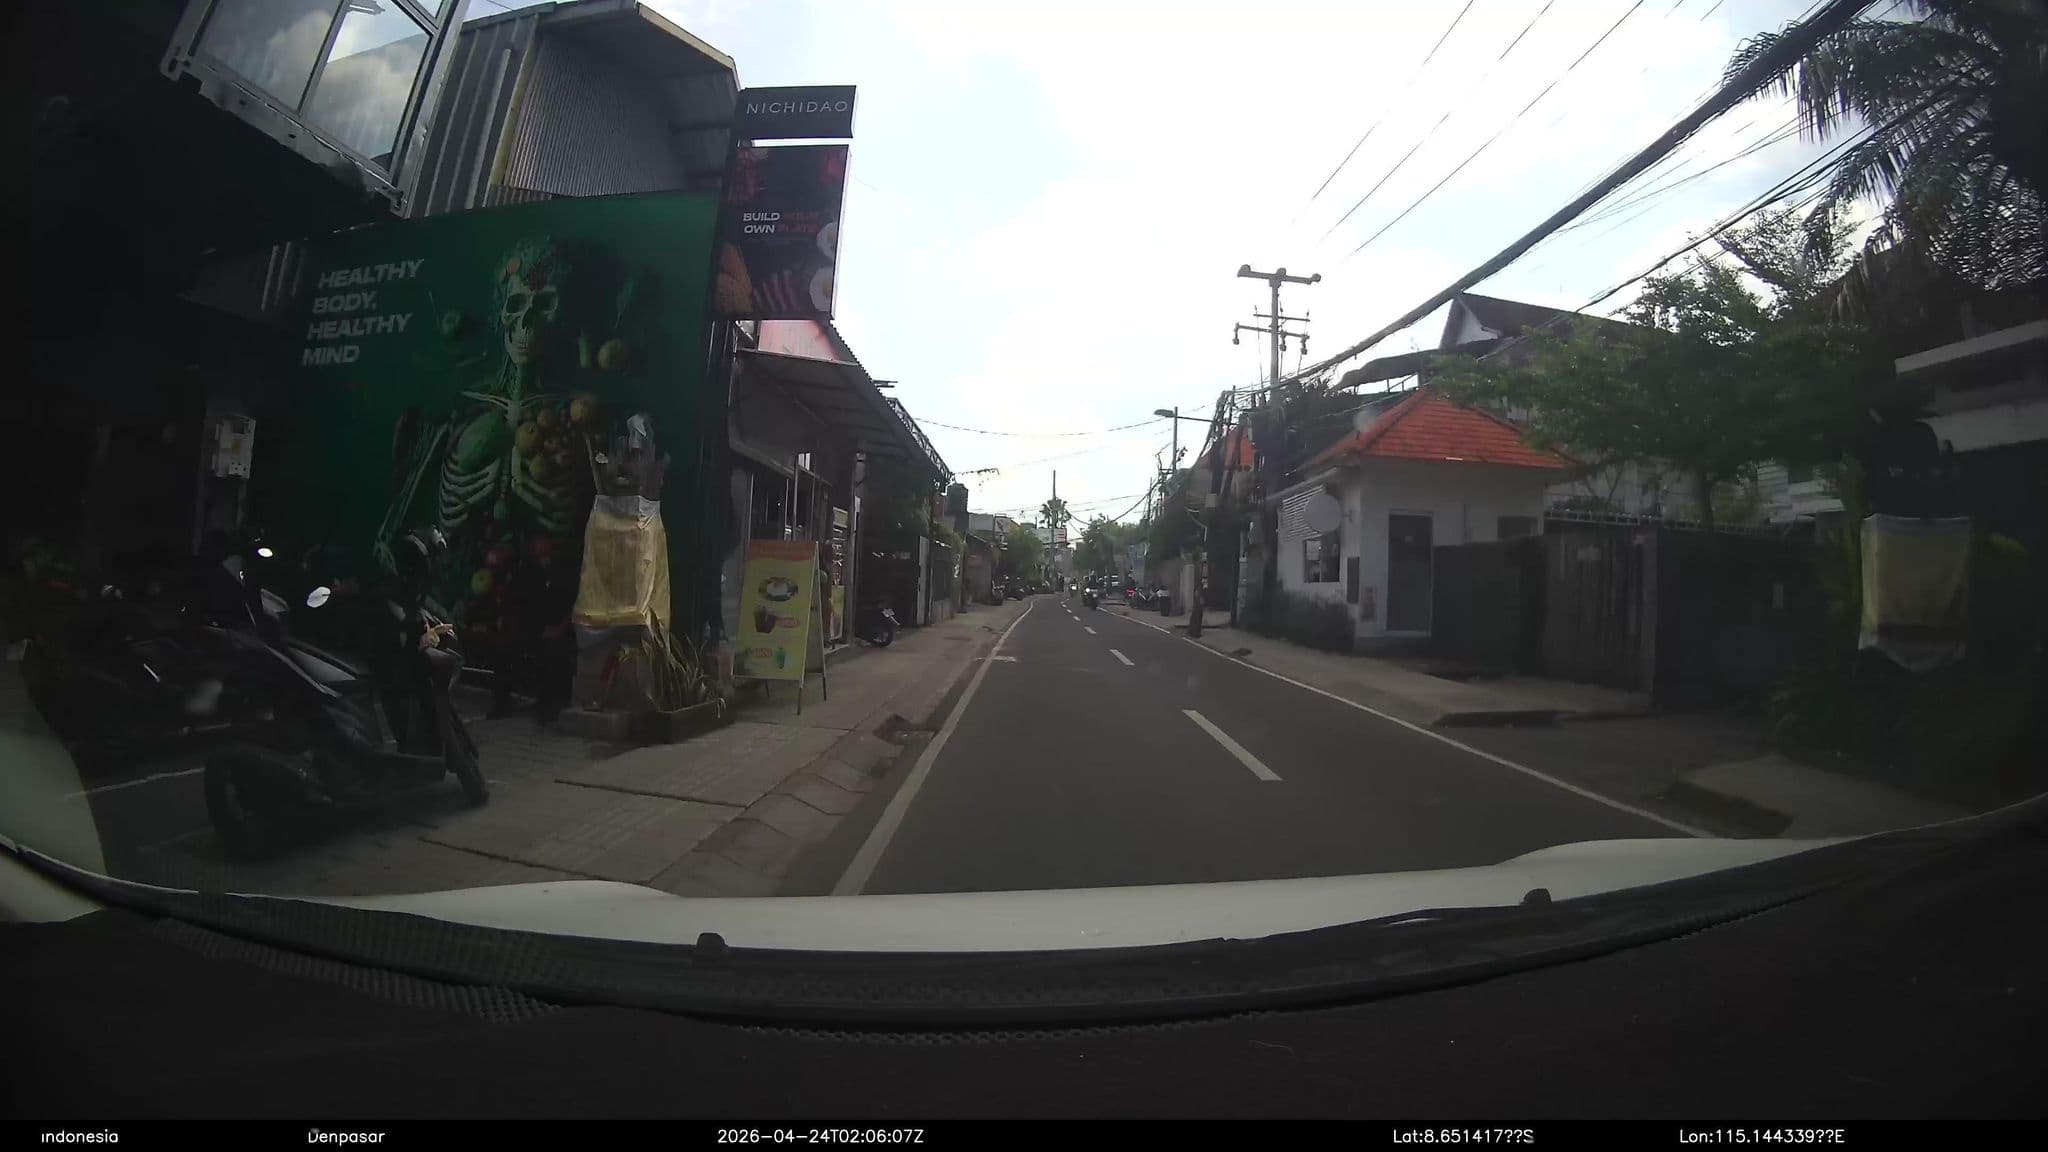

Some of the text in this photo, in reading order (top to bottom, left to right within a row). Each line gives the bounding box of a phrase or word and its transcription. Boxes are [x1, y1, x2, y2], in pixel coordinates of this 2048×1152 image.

[746, 100, 848, 114] NICHIDAO
[743, 212, 781, 222] BUILD
[744, 224, 775, 234] OWN
[318, 258, 425, 288] HEALTHY
[313, 290, 377, 315] BODY,
[306, 313, 413, 340] HEALTHY
[302, 345, 361, 366] MIND
